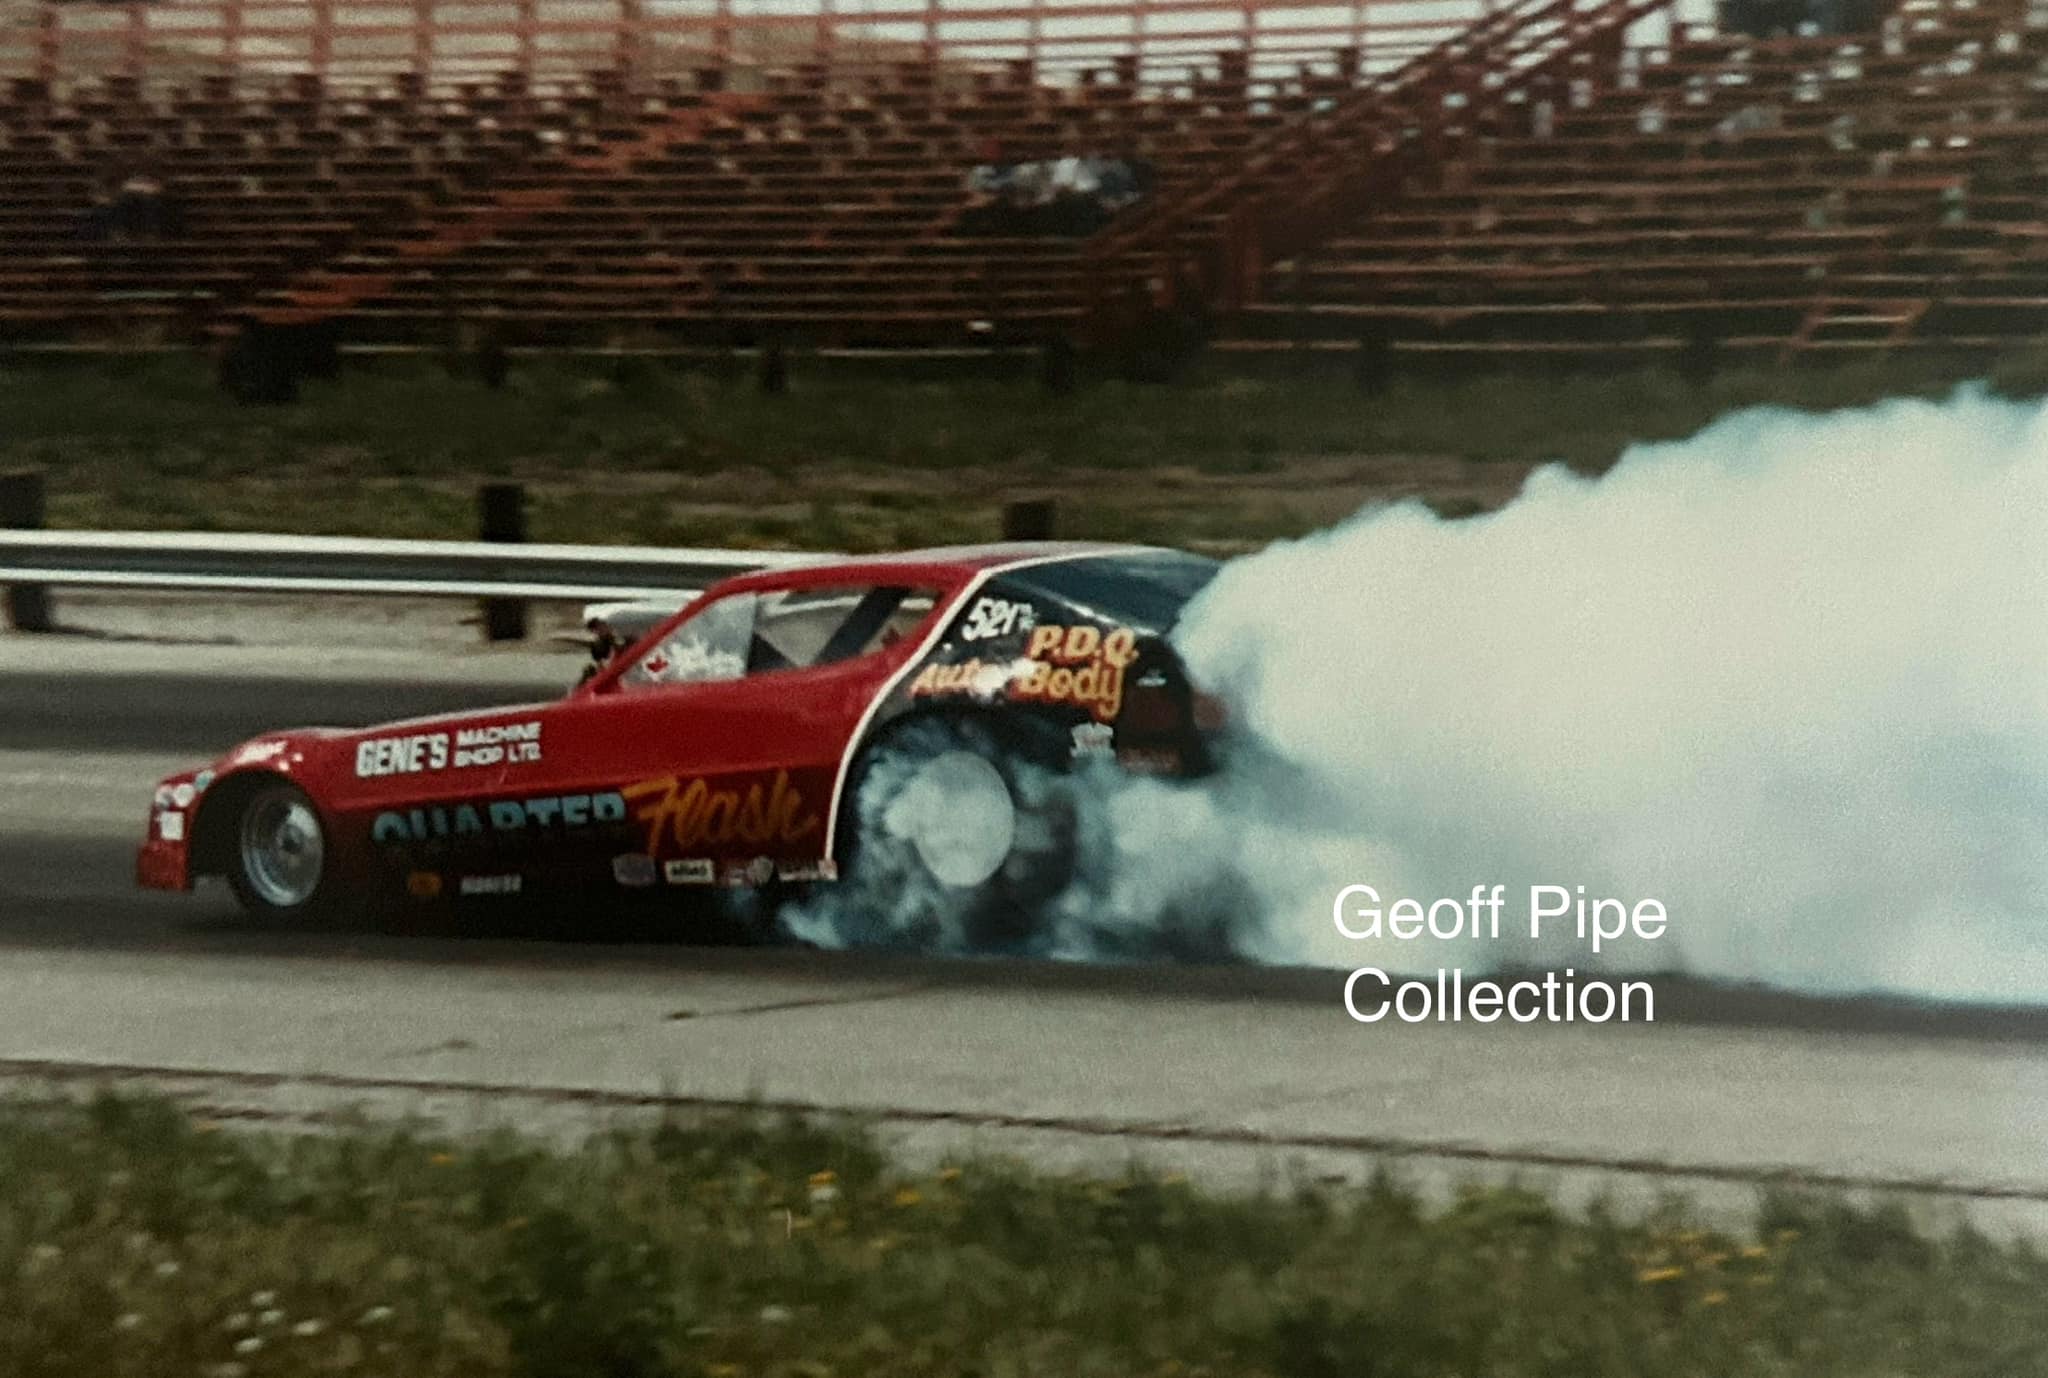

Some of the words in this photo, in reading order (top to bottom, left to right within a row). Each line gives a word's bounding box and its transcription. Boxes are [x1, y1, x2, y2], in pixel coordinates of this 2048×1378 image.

[911, 657, 1004, 694] Aut
[1014, 660, 1125, 719] Body
[356, 733, 449, 777] GENE'S
[456, 721, 541, 746] MACHINE
[454, 746, 504, 767] SHOP
[621, 769, 818, 856] Flash
